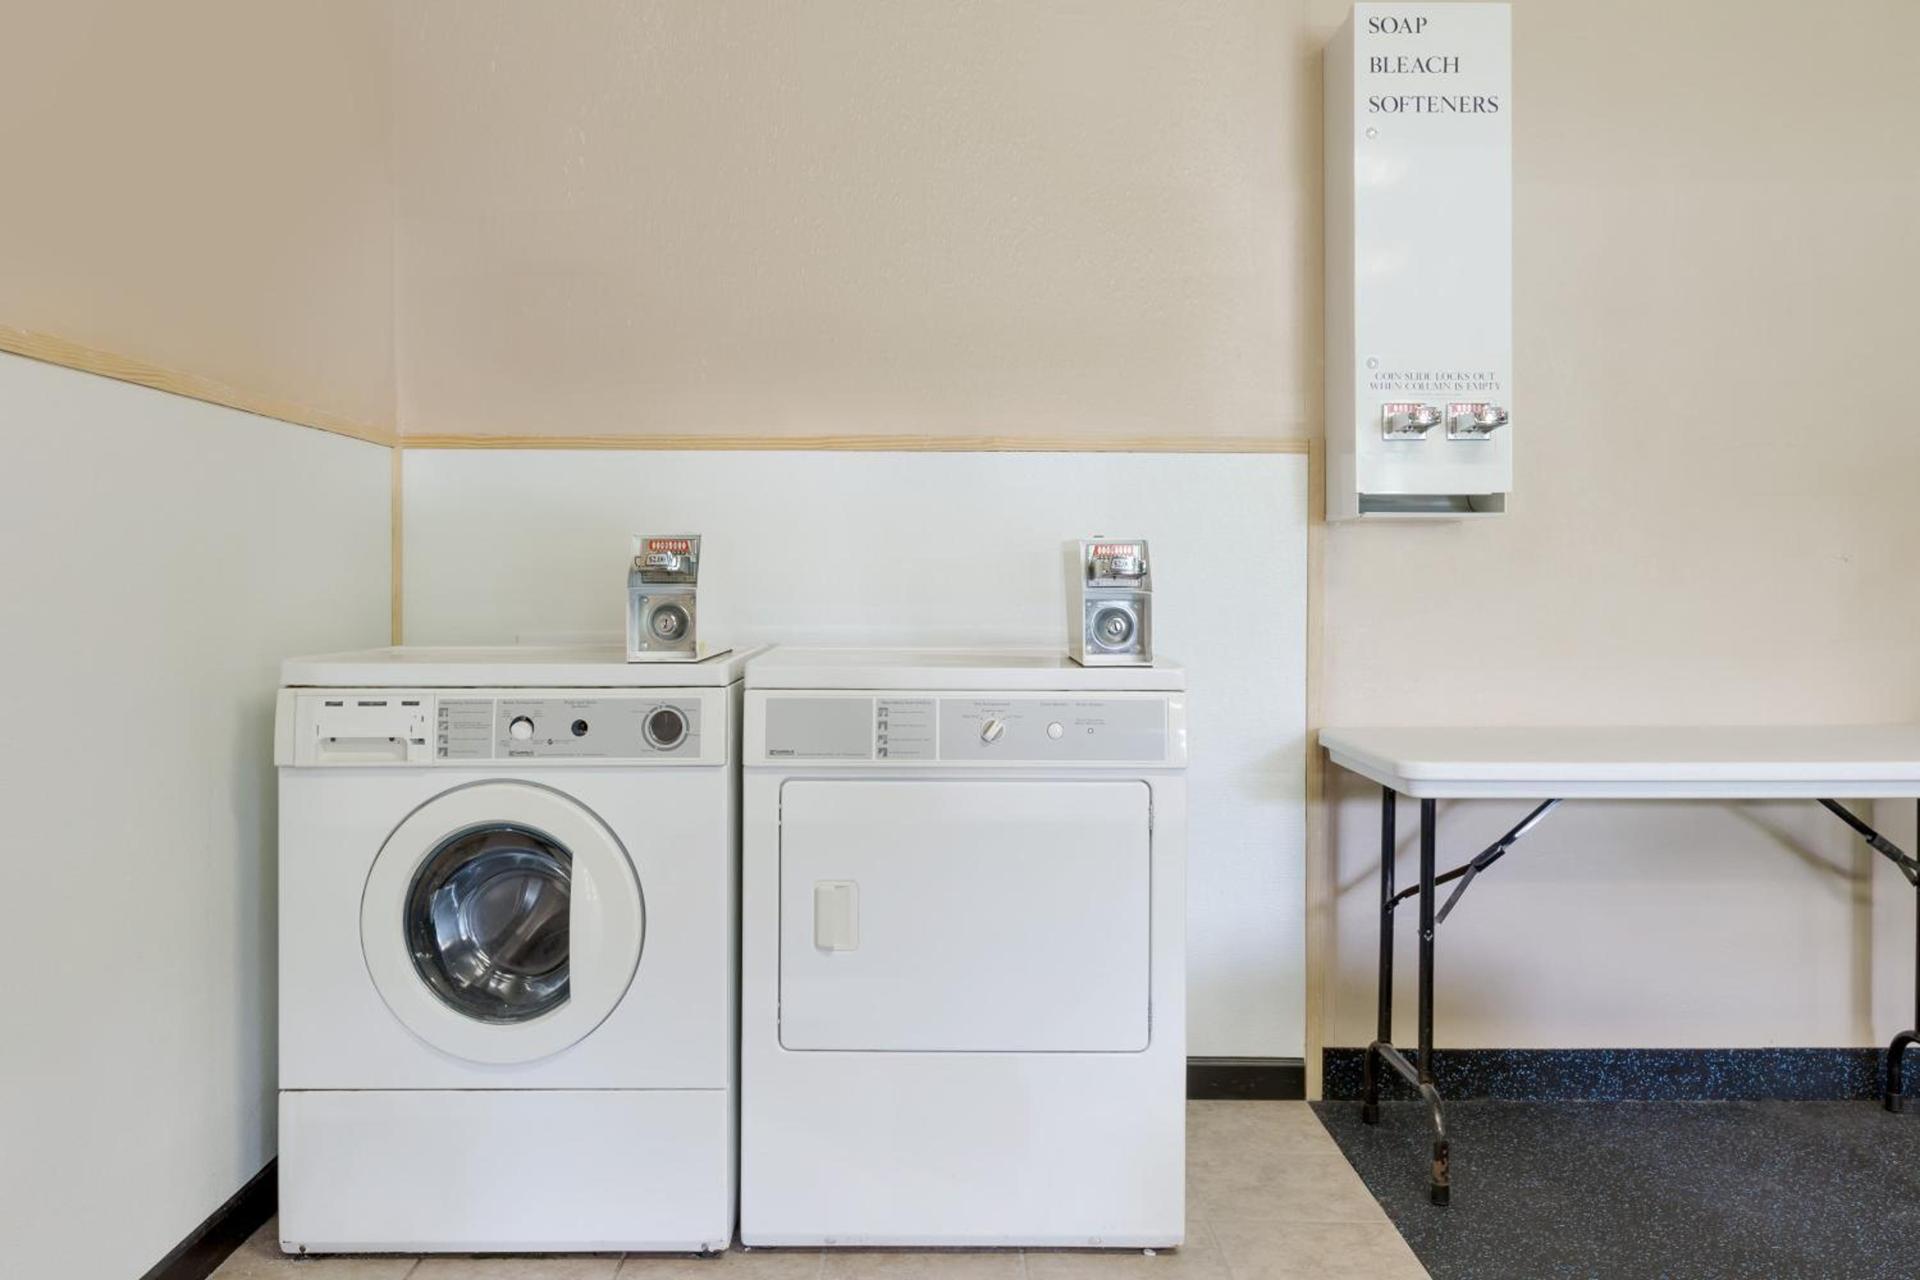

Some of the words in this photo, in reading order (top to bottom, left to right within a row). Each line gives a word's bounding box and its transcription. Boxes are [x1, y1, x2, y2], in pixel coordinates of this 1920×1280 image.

[1368, 16, 1428, 34] SOAP
[1369, 56, 1460, 74] BLEACH
[1368, 95, 1499, 114] SOFTENERS
[1375, 371, 1401, 381] COIN
[1404, 371, 1432, 381] SLIDE
[1435, 371, 1470, 381] LOCKS
[1473, 371, 1496, 381] OUT
[1369, 382, 1402, 391] WHEN
[1404, 382, 1452, 391] COLUMN
[1454, 382, 1463, 391] IS
[1465, 382, 1502, 391] EMPTY
